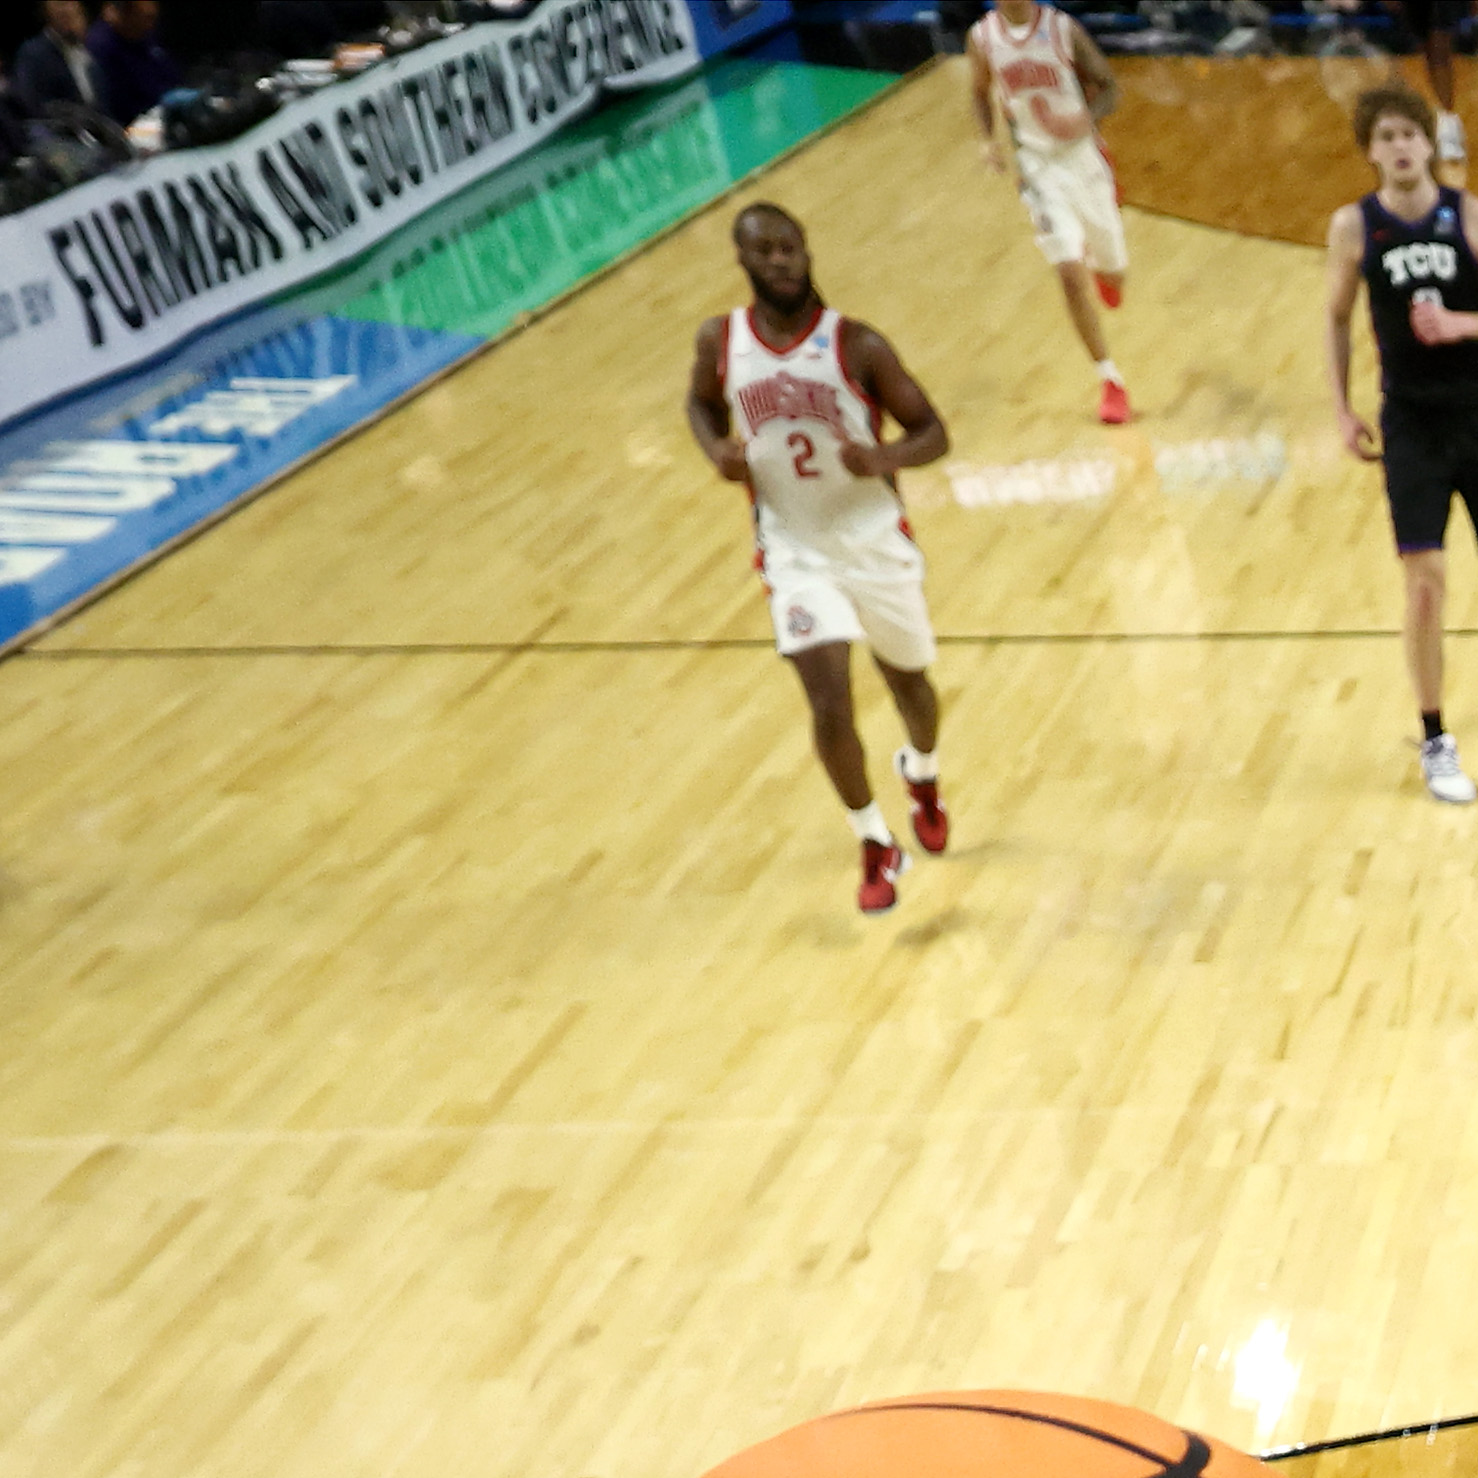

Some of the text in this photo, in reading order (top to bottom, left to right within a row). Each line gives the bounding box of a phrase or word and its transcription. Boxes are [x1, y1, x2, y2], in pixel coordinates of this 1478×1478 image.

[50, 162, 284, 347] FURMAN
[336, 40, 515, 208] SOUTHERN
[1381, 242, 1457, 286] TCU
[786, 431, 823, 480] 2
